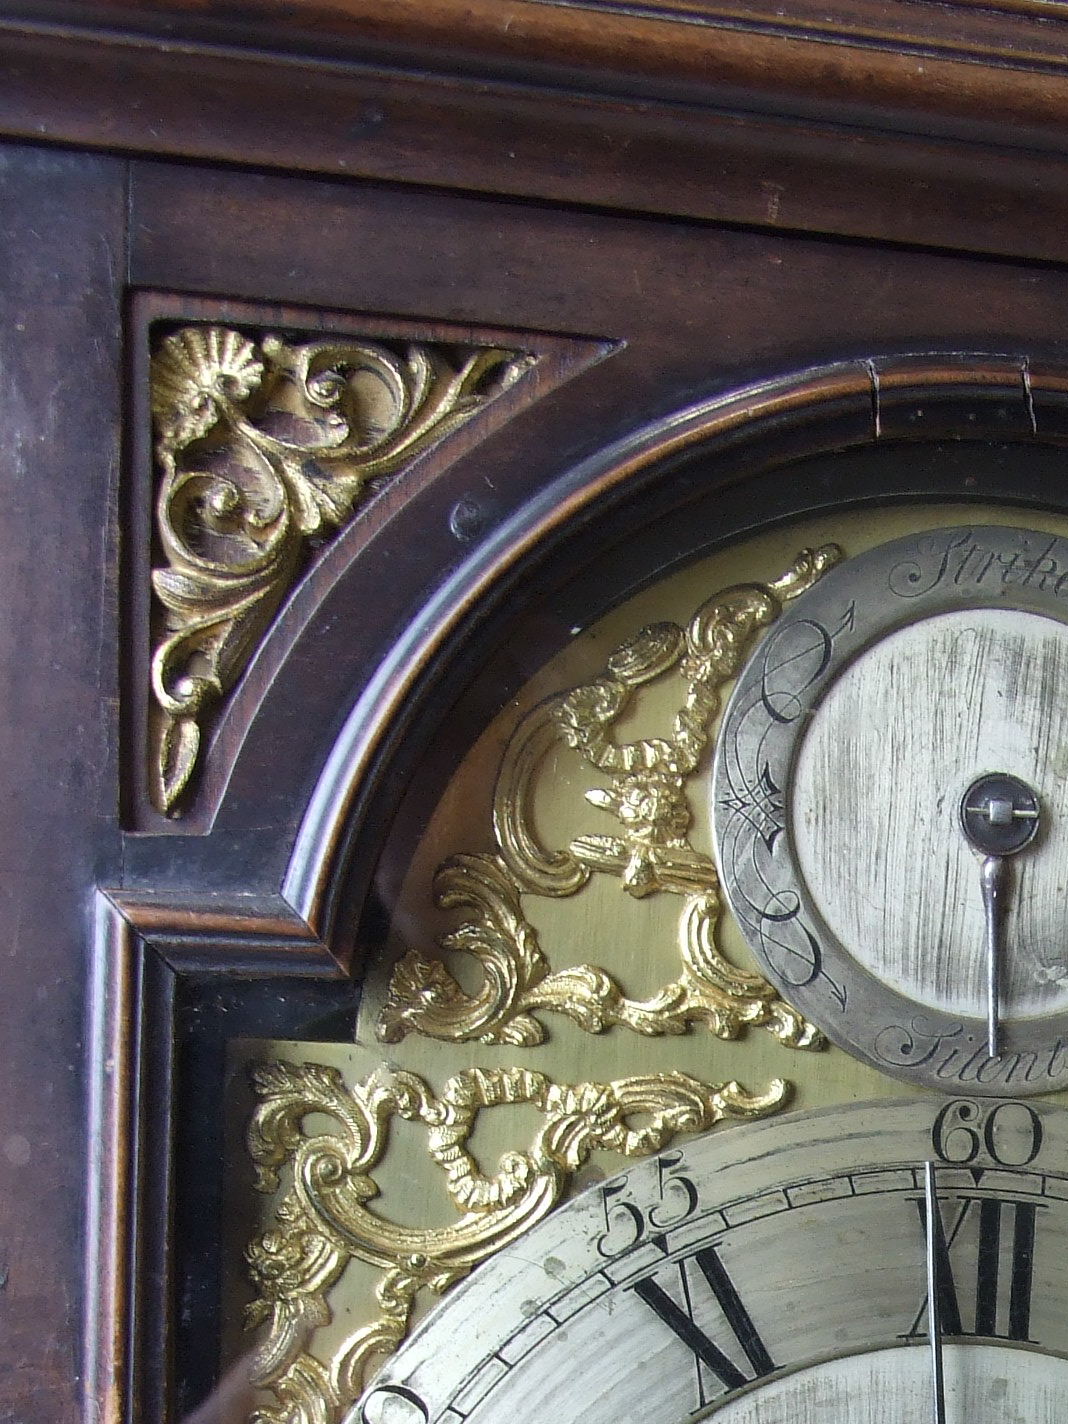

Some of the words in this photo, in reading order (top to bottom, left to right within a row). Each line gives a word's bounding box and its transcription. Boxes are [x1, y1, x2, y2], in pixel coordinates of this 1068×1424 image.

[932, 1099, 1043, 1167] 60
[597, 1149, 698, 1259] 55
[623, 1241, 786, 1415] XI
[897, 1195, 1050, 1345] XII
